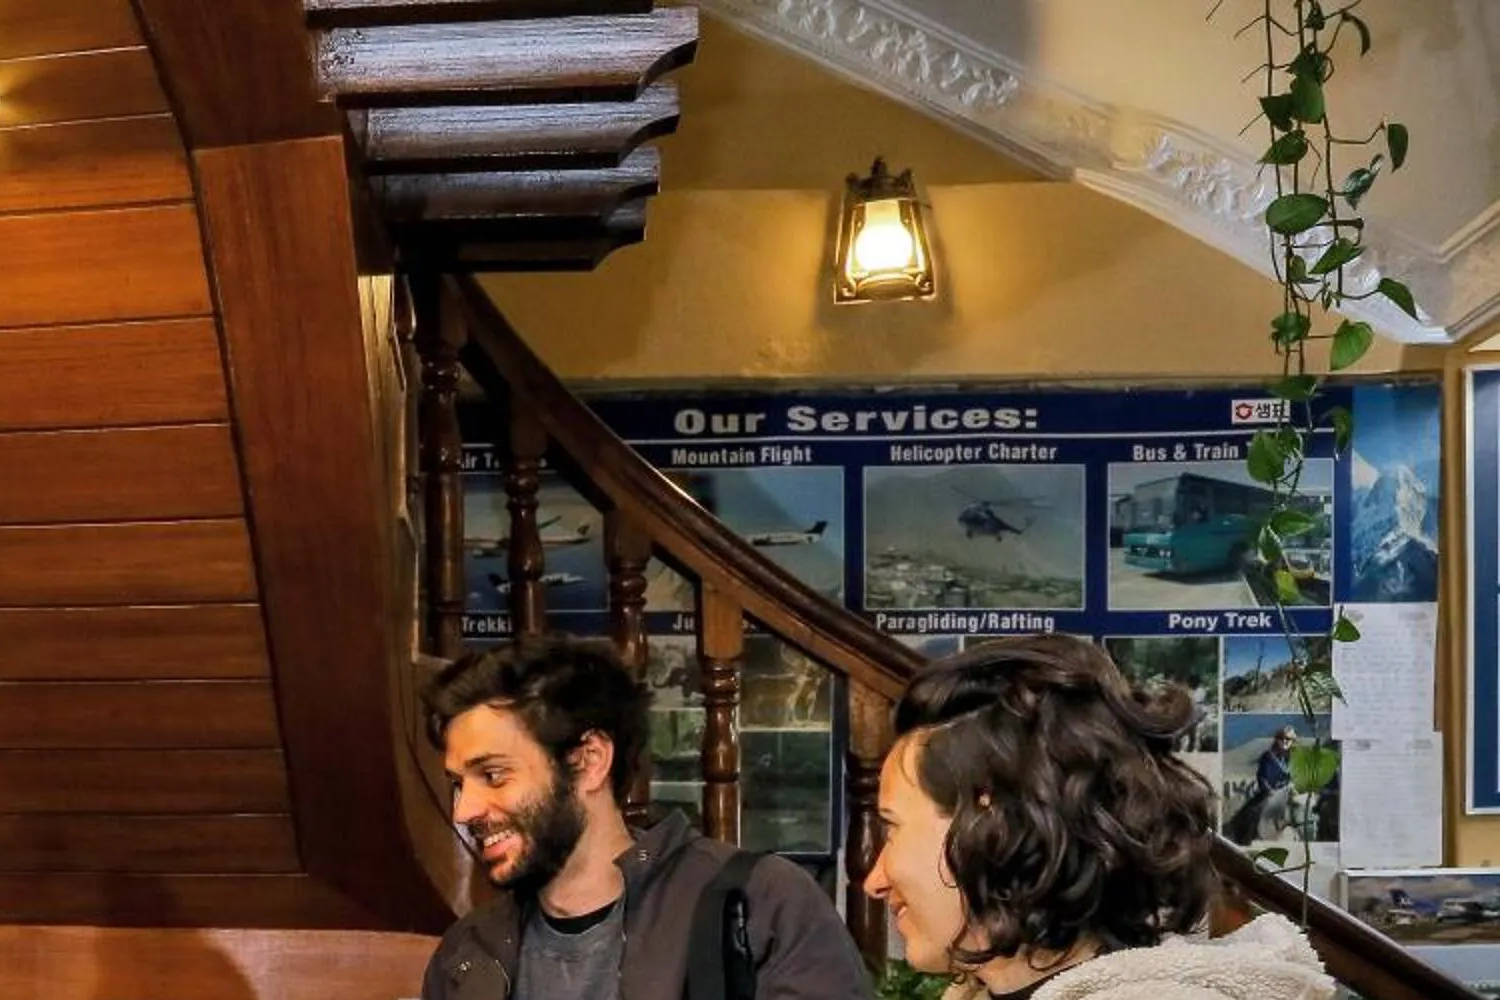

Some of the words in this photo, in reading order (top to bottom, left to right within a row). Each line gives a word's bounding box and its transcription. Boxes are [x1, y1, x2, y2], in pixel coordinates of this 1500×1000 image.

[674, 407, 766, 435] Our
[786, 404, 1039, 433] Services:
[671, 446, 755, 466] Mountain
[760, 444, 813, 467] Flight
[890, 443, 982, 465] Helicopter
[988, 442, 1057, 461] Charter
[1132, 444, 1167, 462] Bus
[1173, 442, 1187, 461] &
[1193, 442, 1239, 460] Train
[461, 614, 514, 633] Trekki
[876, 612, 1055, 633] Paragliding/Rafting
[1168, 613, 1219, 632] Pony
[1223, 611, 1272, 629] Trek
